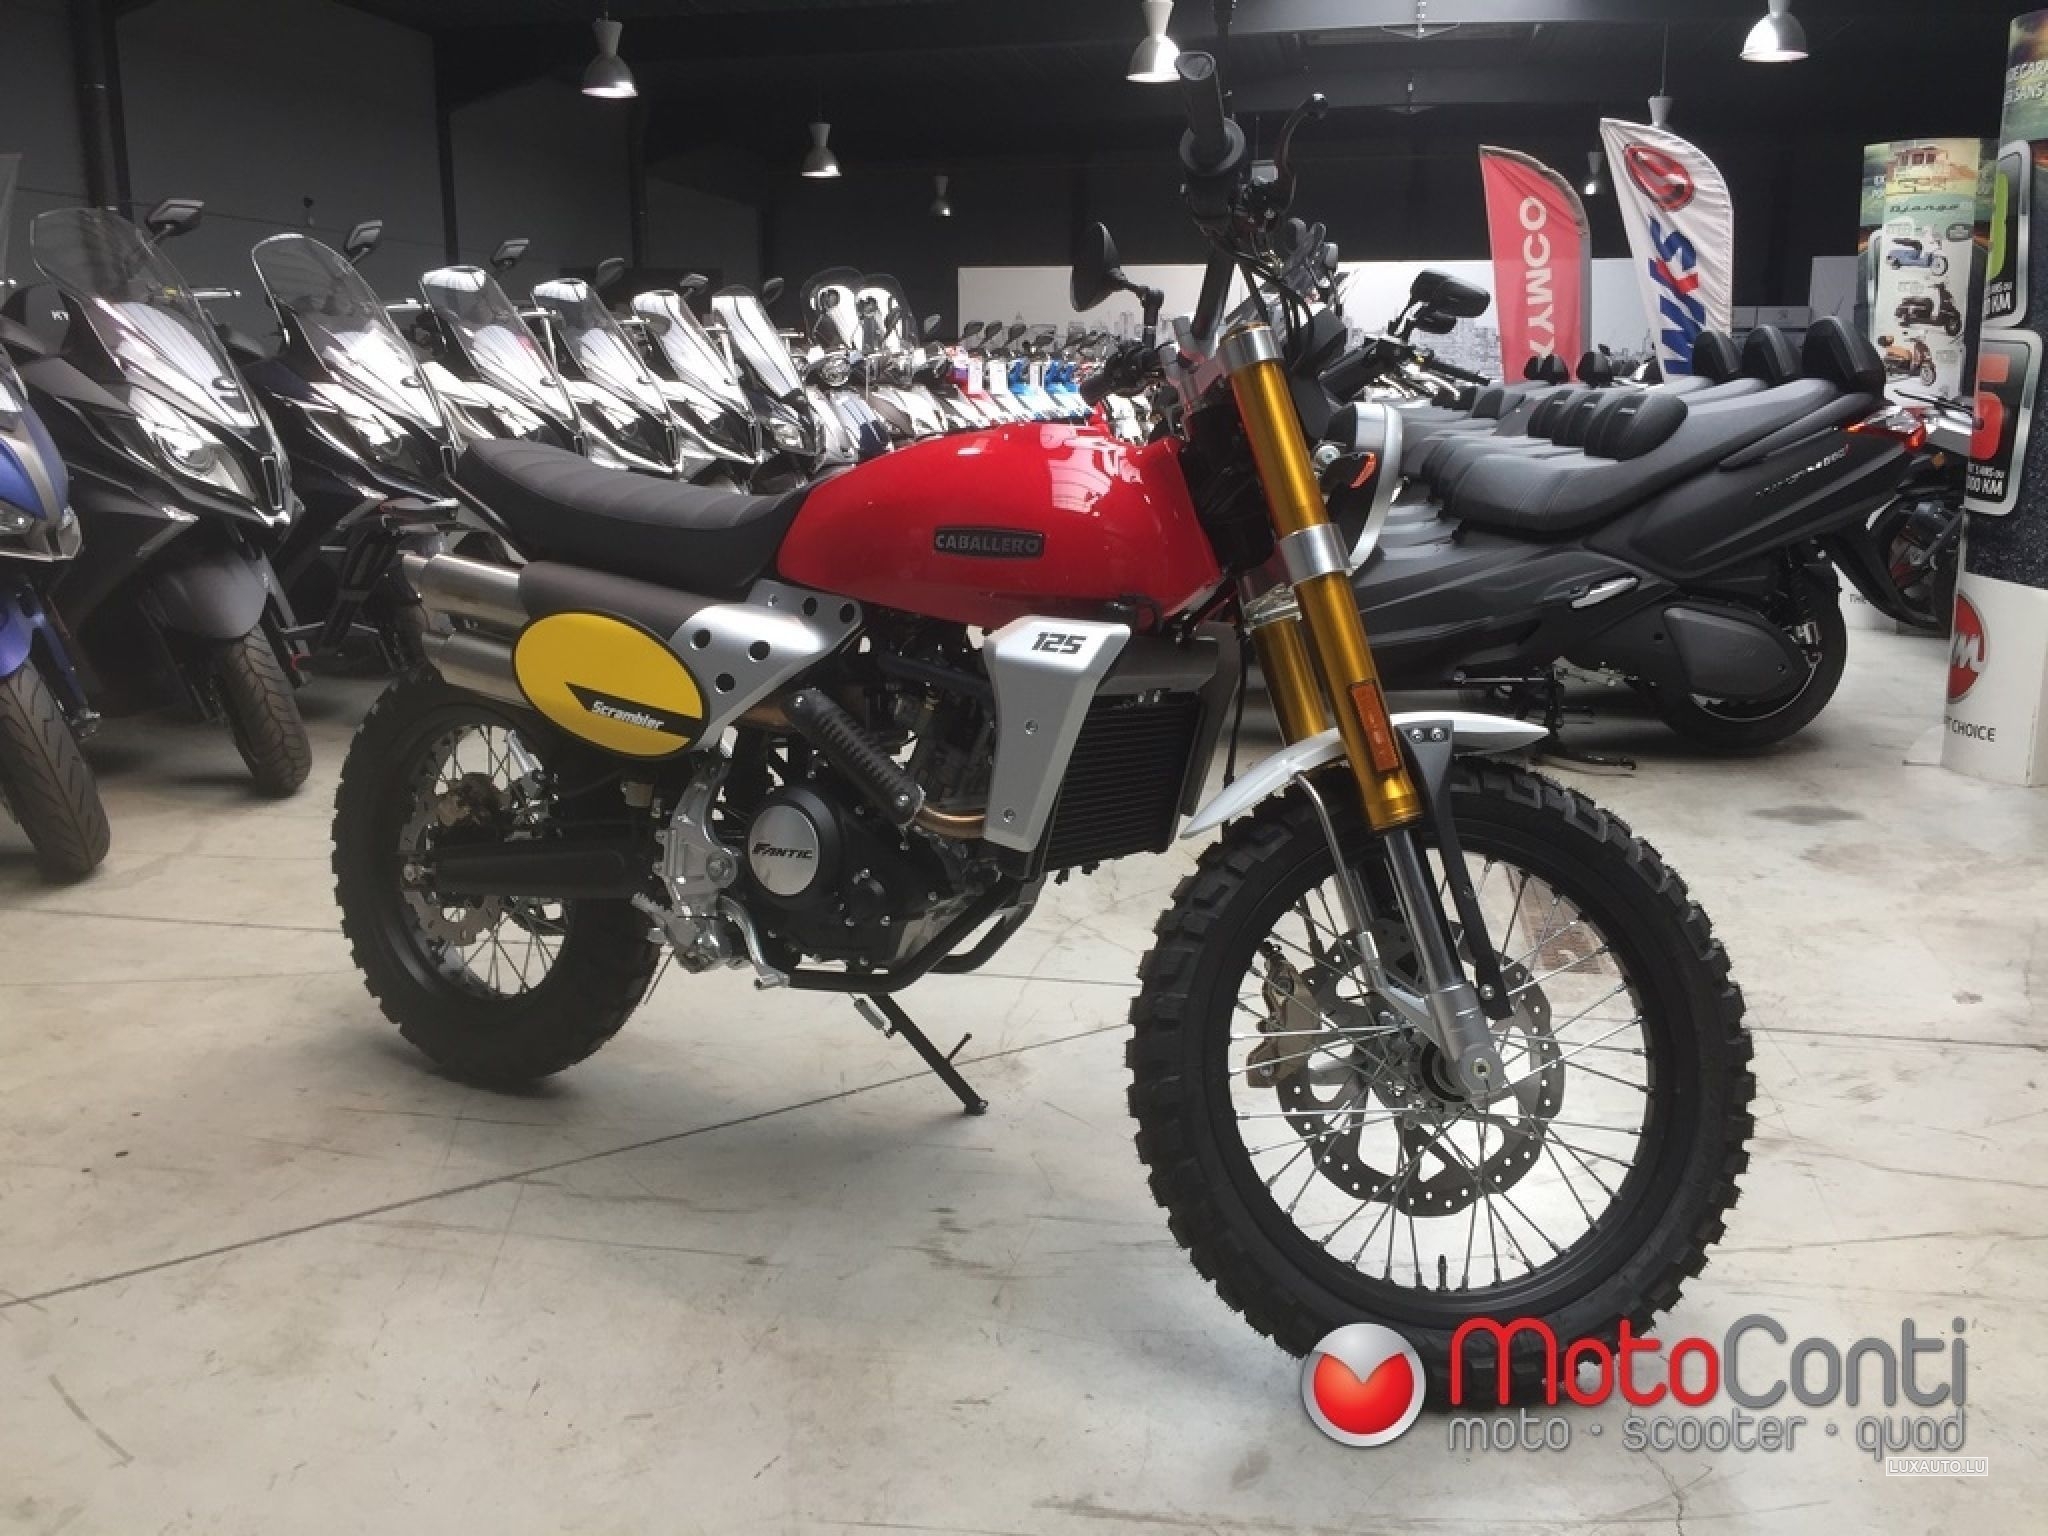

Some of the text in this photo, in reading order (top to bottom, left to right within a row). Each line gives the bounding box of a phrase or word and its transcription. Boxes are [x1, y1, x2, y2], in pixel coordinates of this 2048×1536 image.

[935, 535, 1039, 553] CABALLERO
[1032, 632, 1088, 655] 125
[592, 700, 665, 730] Scrambler
[1951, 719, 1997, 743] CHOICE
